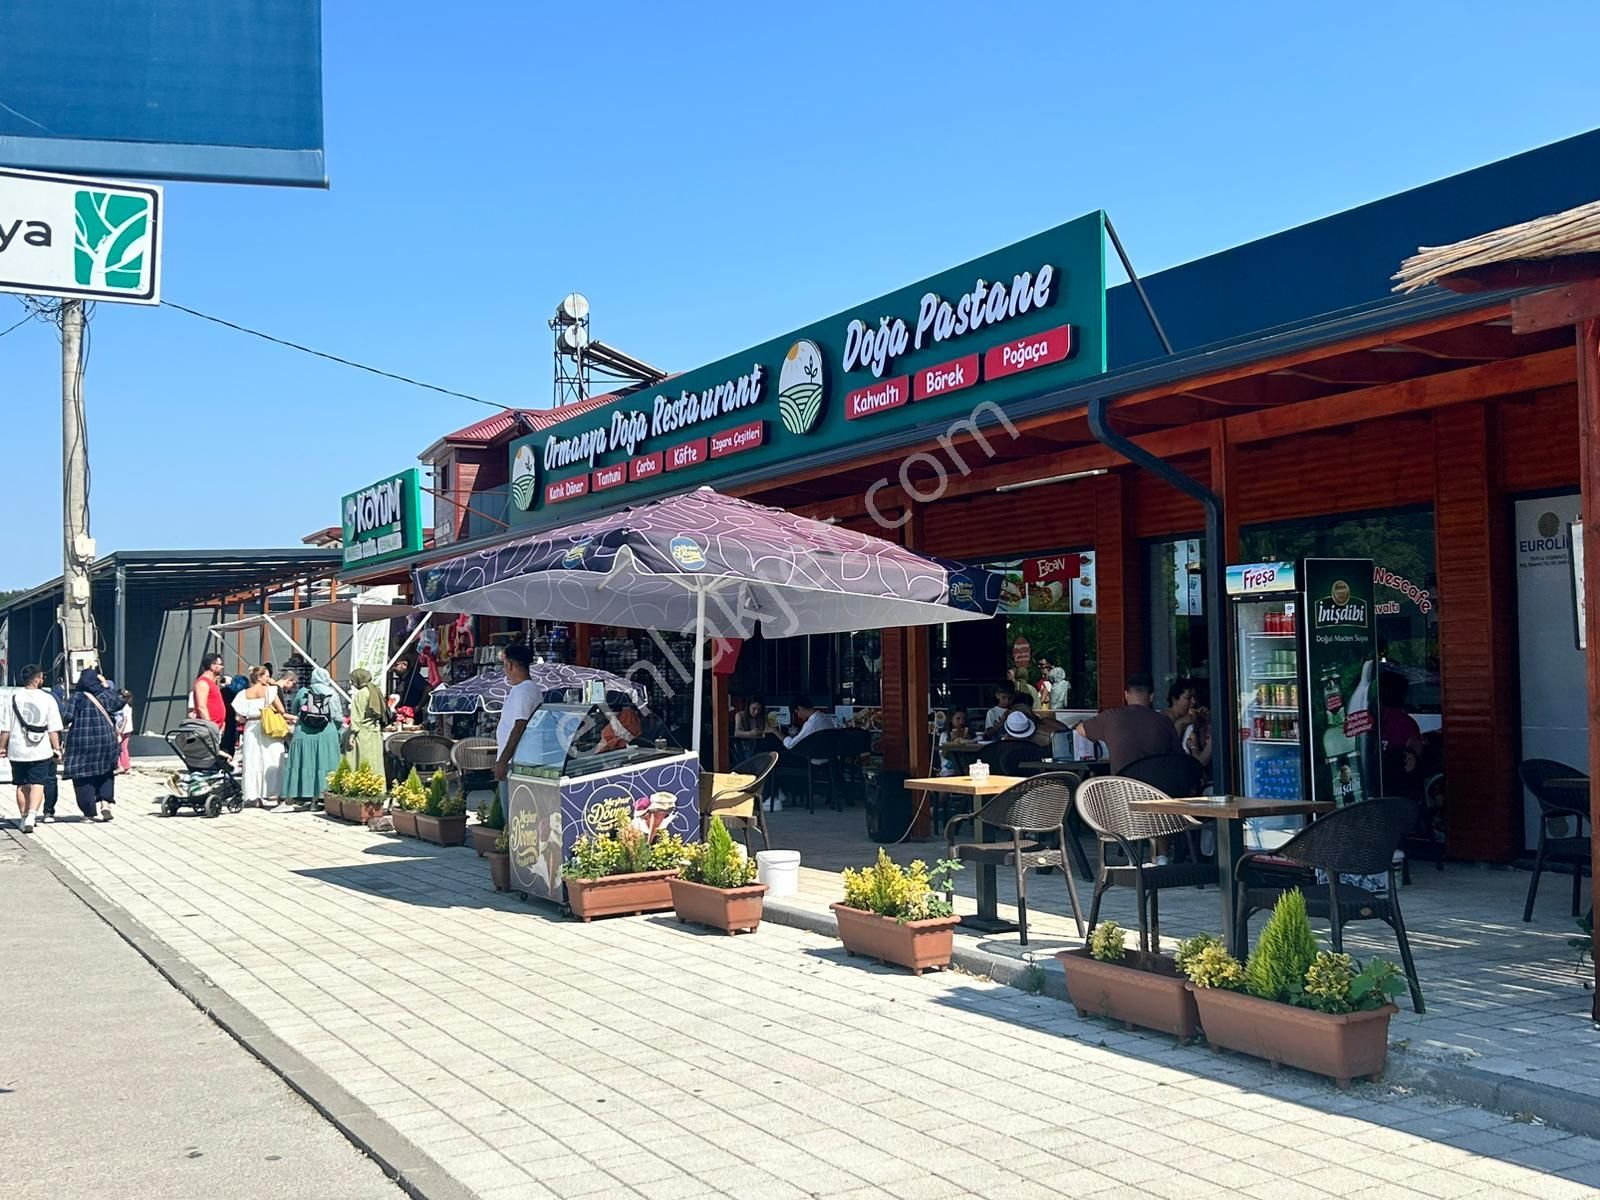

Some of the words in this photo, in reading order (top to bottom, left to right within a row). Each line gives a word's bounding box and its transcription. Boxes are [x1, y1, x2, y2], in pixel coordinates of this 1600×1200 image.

[0, 220, 51, 253] ya
[842, 316, 909, 378] Doğa
[915, 264, 1053, 350] Pastane
[1003, 341, 1048, 368] Poğaça
[926, 364, 964, 393] Börek
[853, 386, 899, 414] Kahvaltı
[544, 427, 607, 471] Ormanya
[609, 410, 649, 456] Doğa
[651, 363, 762, 436] Restaurant
[674, 445, 697, 466] Köfte
